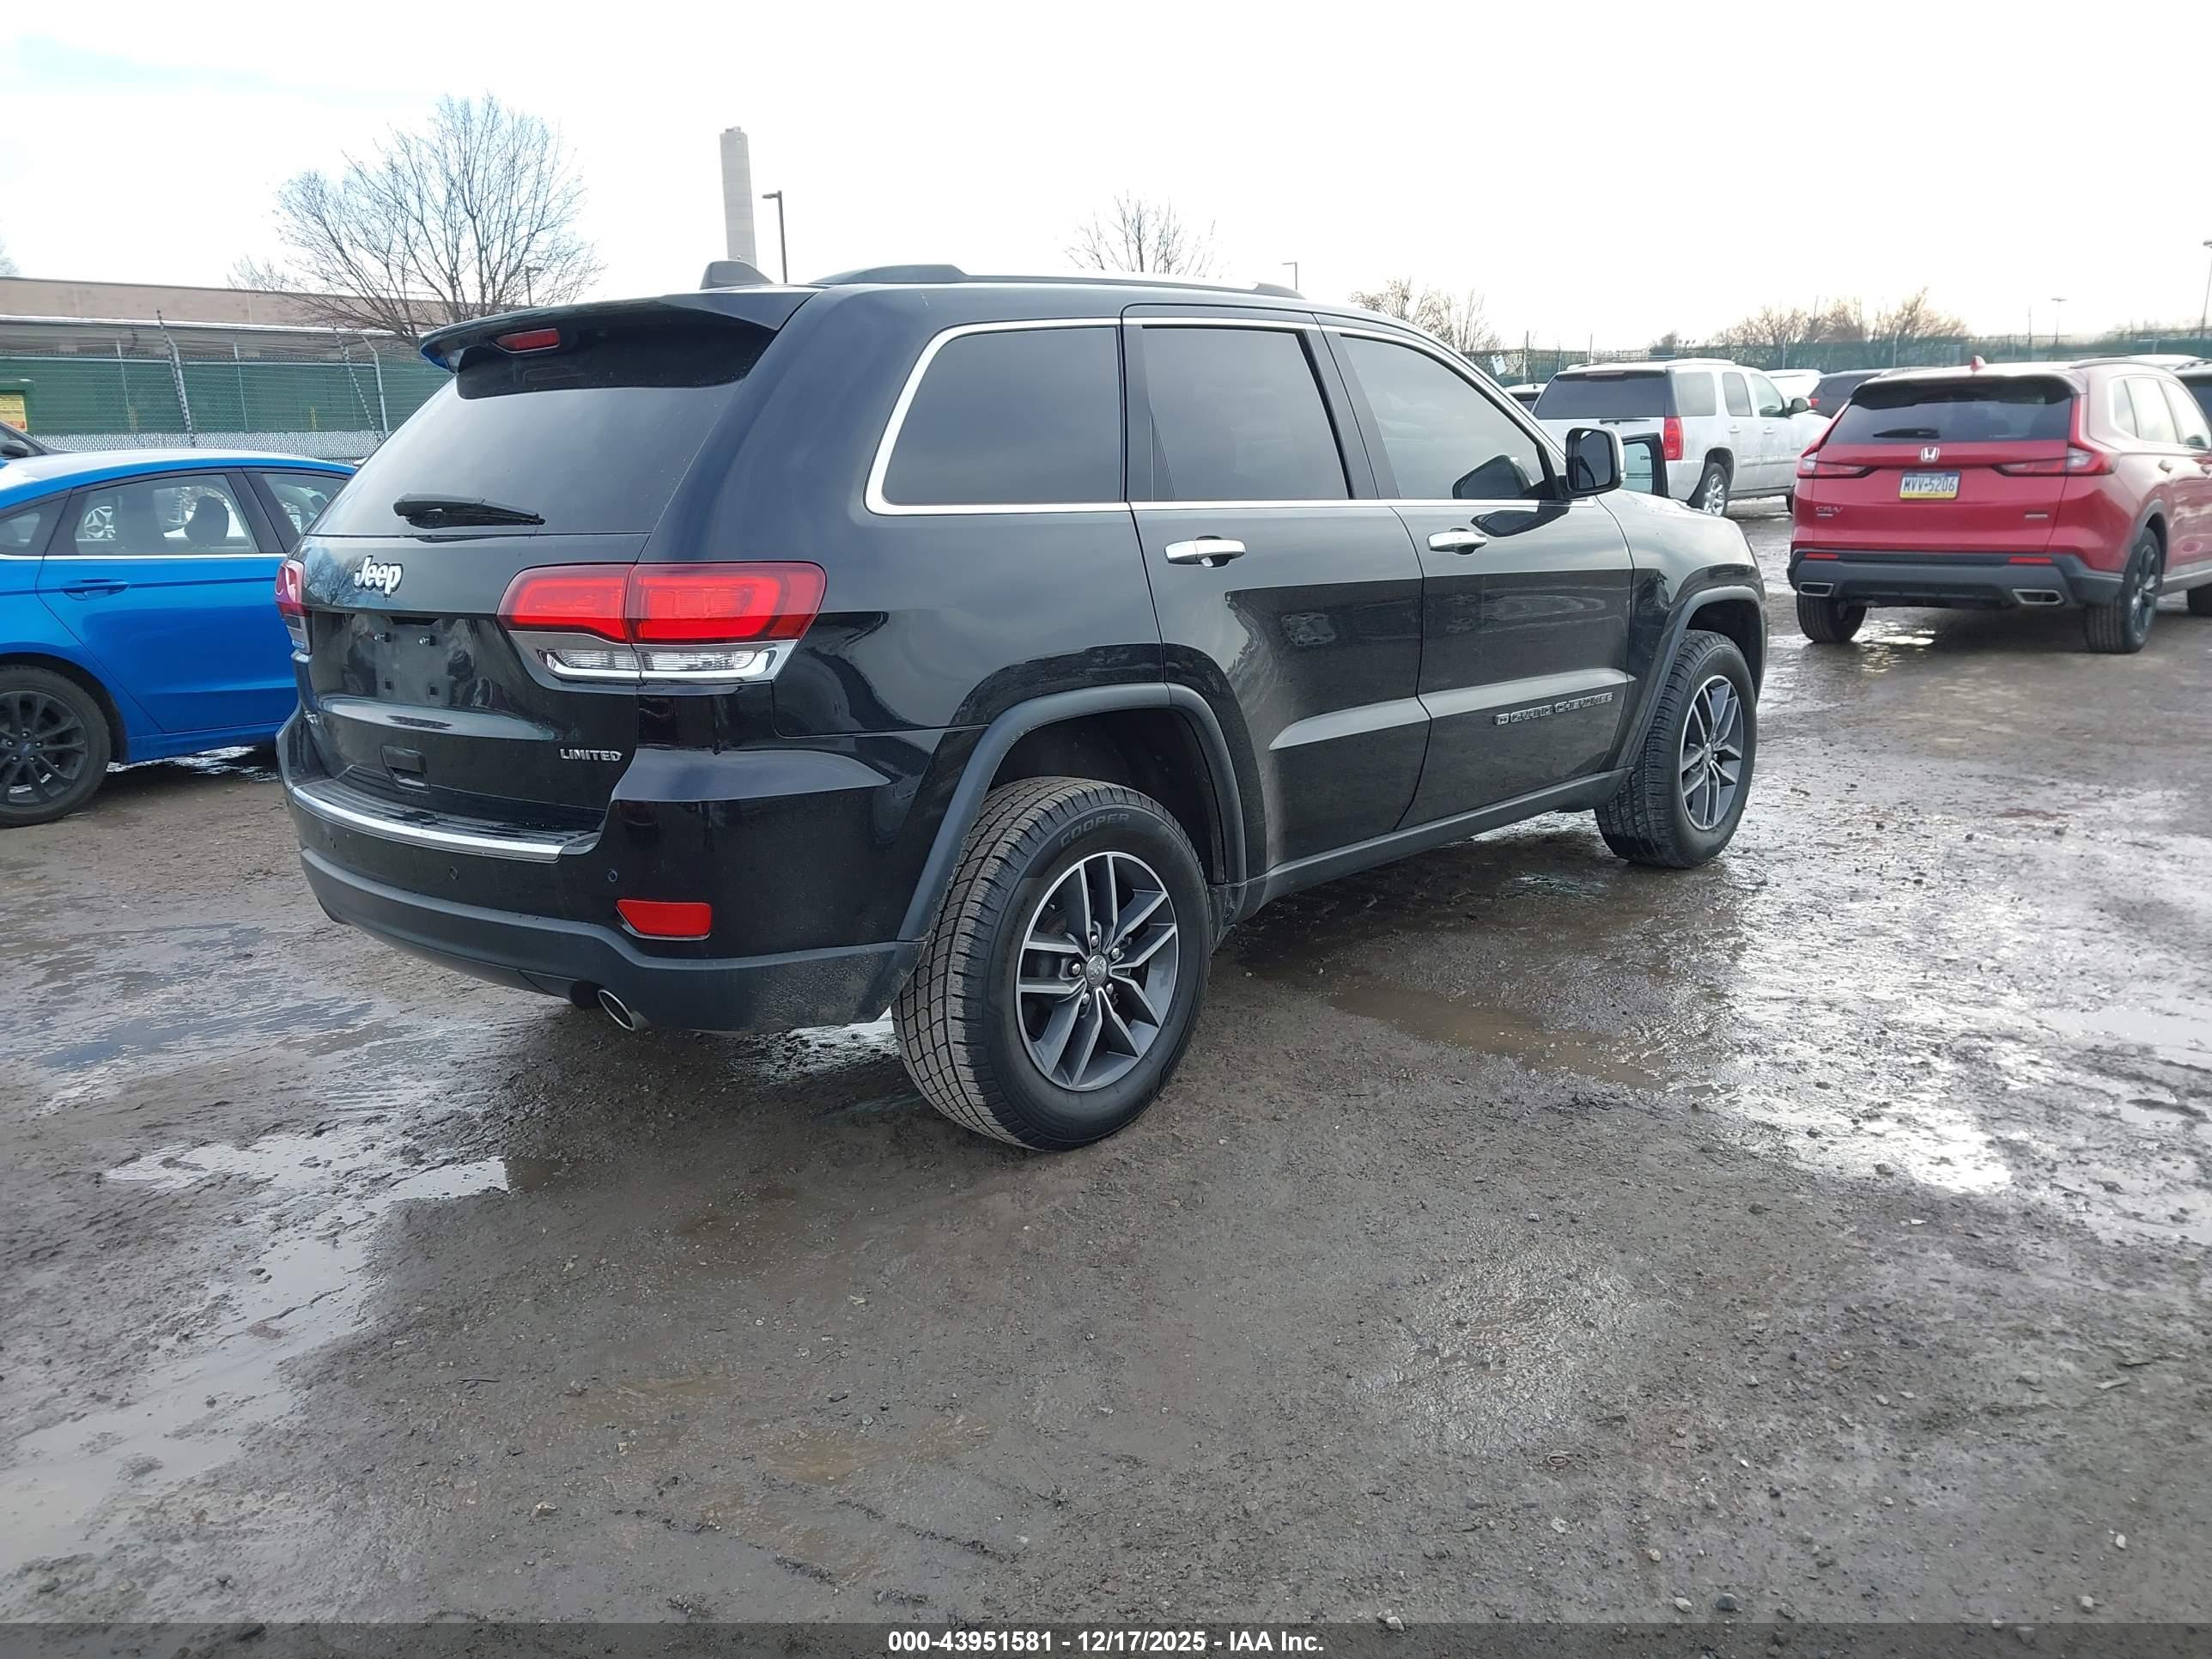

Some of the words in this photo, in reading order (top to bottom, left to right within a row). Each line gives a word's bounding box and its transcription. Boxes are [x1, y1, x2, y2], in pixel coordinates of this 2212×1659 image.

[353, 555, 404, 599] Jeep
[560, 748, 623, 762] LIMITED
[1060, 813, 1129, 848] COOPER
